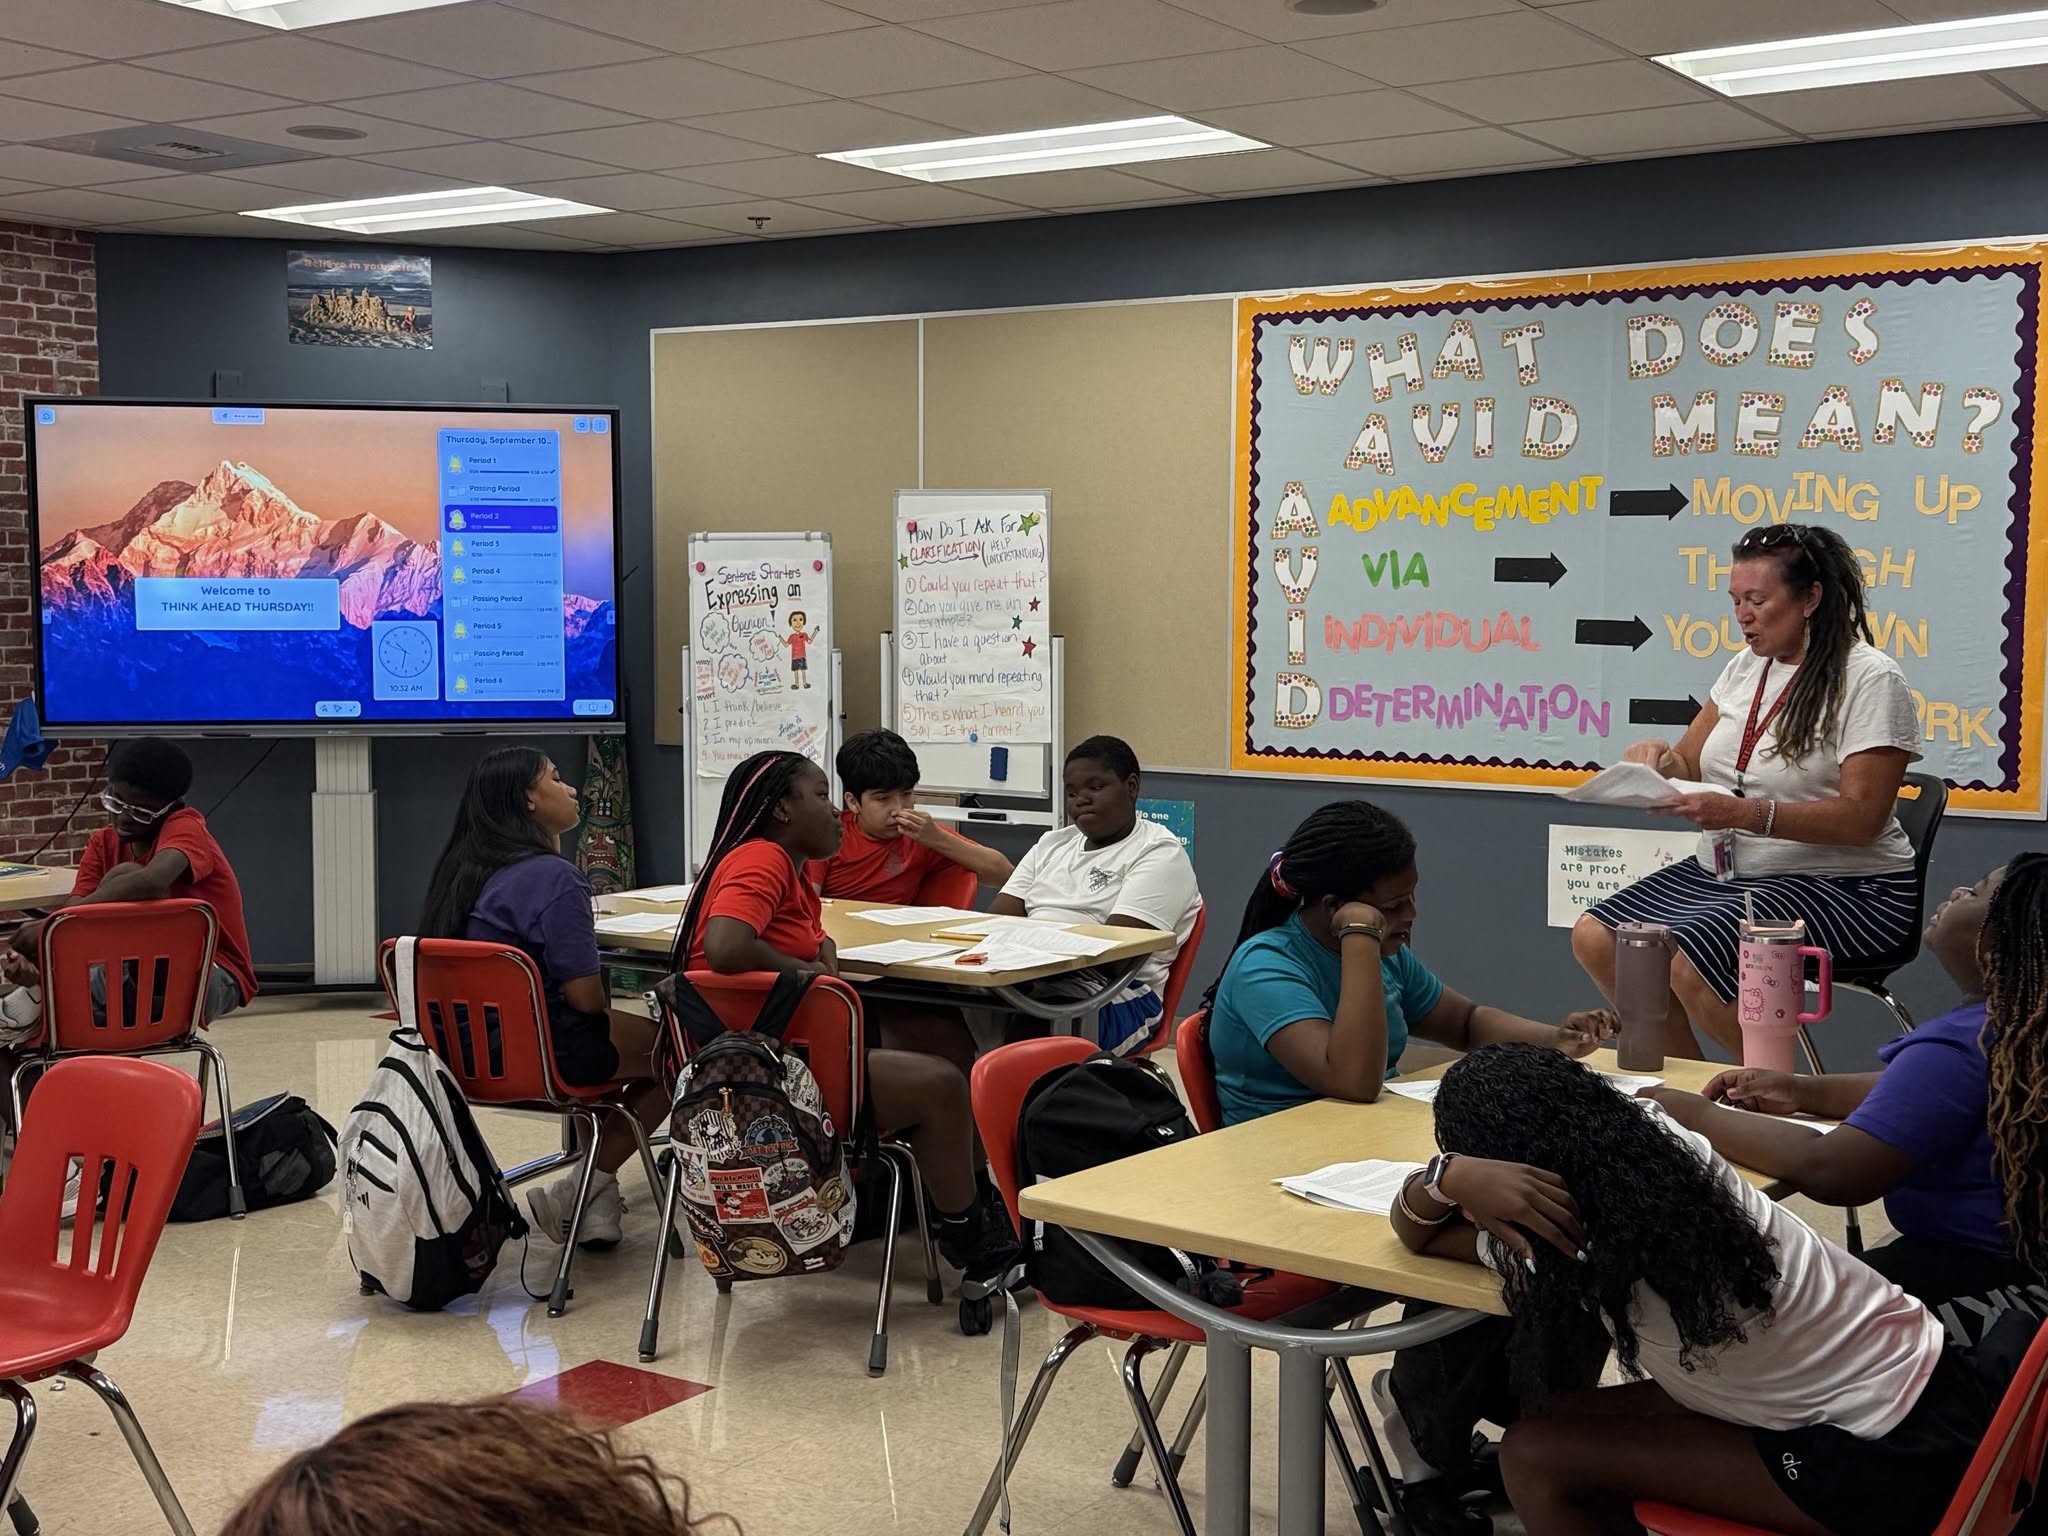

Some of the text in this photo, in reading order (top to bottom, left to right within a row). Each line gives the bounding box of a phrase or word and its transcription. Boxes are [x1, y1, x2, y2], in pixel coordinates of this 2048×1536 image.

[1288, 296, 1881, 403] WHAT DOES
[1343, 378, 2004, 476] AVID MEAN?
[446, 435, 487, 445] Thursday,
[490, 436, 535, 446] September
[470, 485, 496, 493] Passing
[1327, 471, 1982, 533] ADVANCEMENT MOVING UP
[940, 521, 953, 539] Do
[956, 518, 968, 537] I
[974, 517, 994, 534] Ask
[1001, 514, 1017, 534] For
[910, 539, 981, 562] CLARIFICATION
[718, 563, 801, 585] Sentence Starters
[1361, 549, 1430, 589] VIA
[201, 586, 271, 596] Welcome to
[705, 578, 801, 615] Expressing an
[920, 575, 948, 593] Could
[952, 581, 971, 598] you
[974, 576, 1008, 595] repeat
[161, 602, 314, 612] THINK AHEAD THURSDAY!!
[473, 595, 499, 603] Passing
[918, 599, 936, 614] Can
[939, 602, 957, 619] you
[959, 602, 983, 618] give
[917, 632, 930, 649] I
[934, 632, 959, 649] have
[962, 637, 969, 648] a
[974, 632, 1018, 654] question
[1324, 611, 1541, 654] INDIVIDUAL
[1663, 612, 1745, 658] YOU
[474, 650, 500, 658] Passing
[916, 669, 947, 686] Would
[950, 672, 966, 691] you
[968, 668, 994, 684] mind
[997, 667, 1043, 692] repeating
[711, 700, 720, 713] I
[917, 706, 939, 721] This
[979, 702, 992, 718] I
[994, 700, 1024, 718] heard
[1028, 704, 1045, 722] you
[1328, 681, 1611, 738] DETERMINATION
[713, 717, 721, 730] I
[725, 719, 757, 732] predict
[712, 732, 725, 744] In
[1151, 812, 1169, 820] one
[1564, 845, 1623, 858] Mistakes
[1560, 862, 1627, 875] are proof
[1567, 879, 1620, 890] you are
